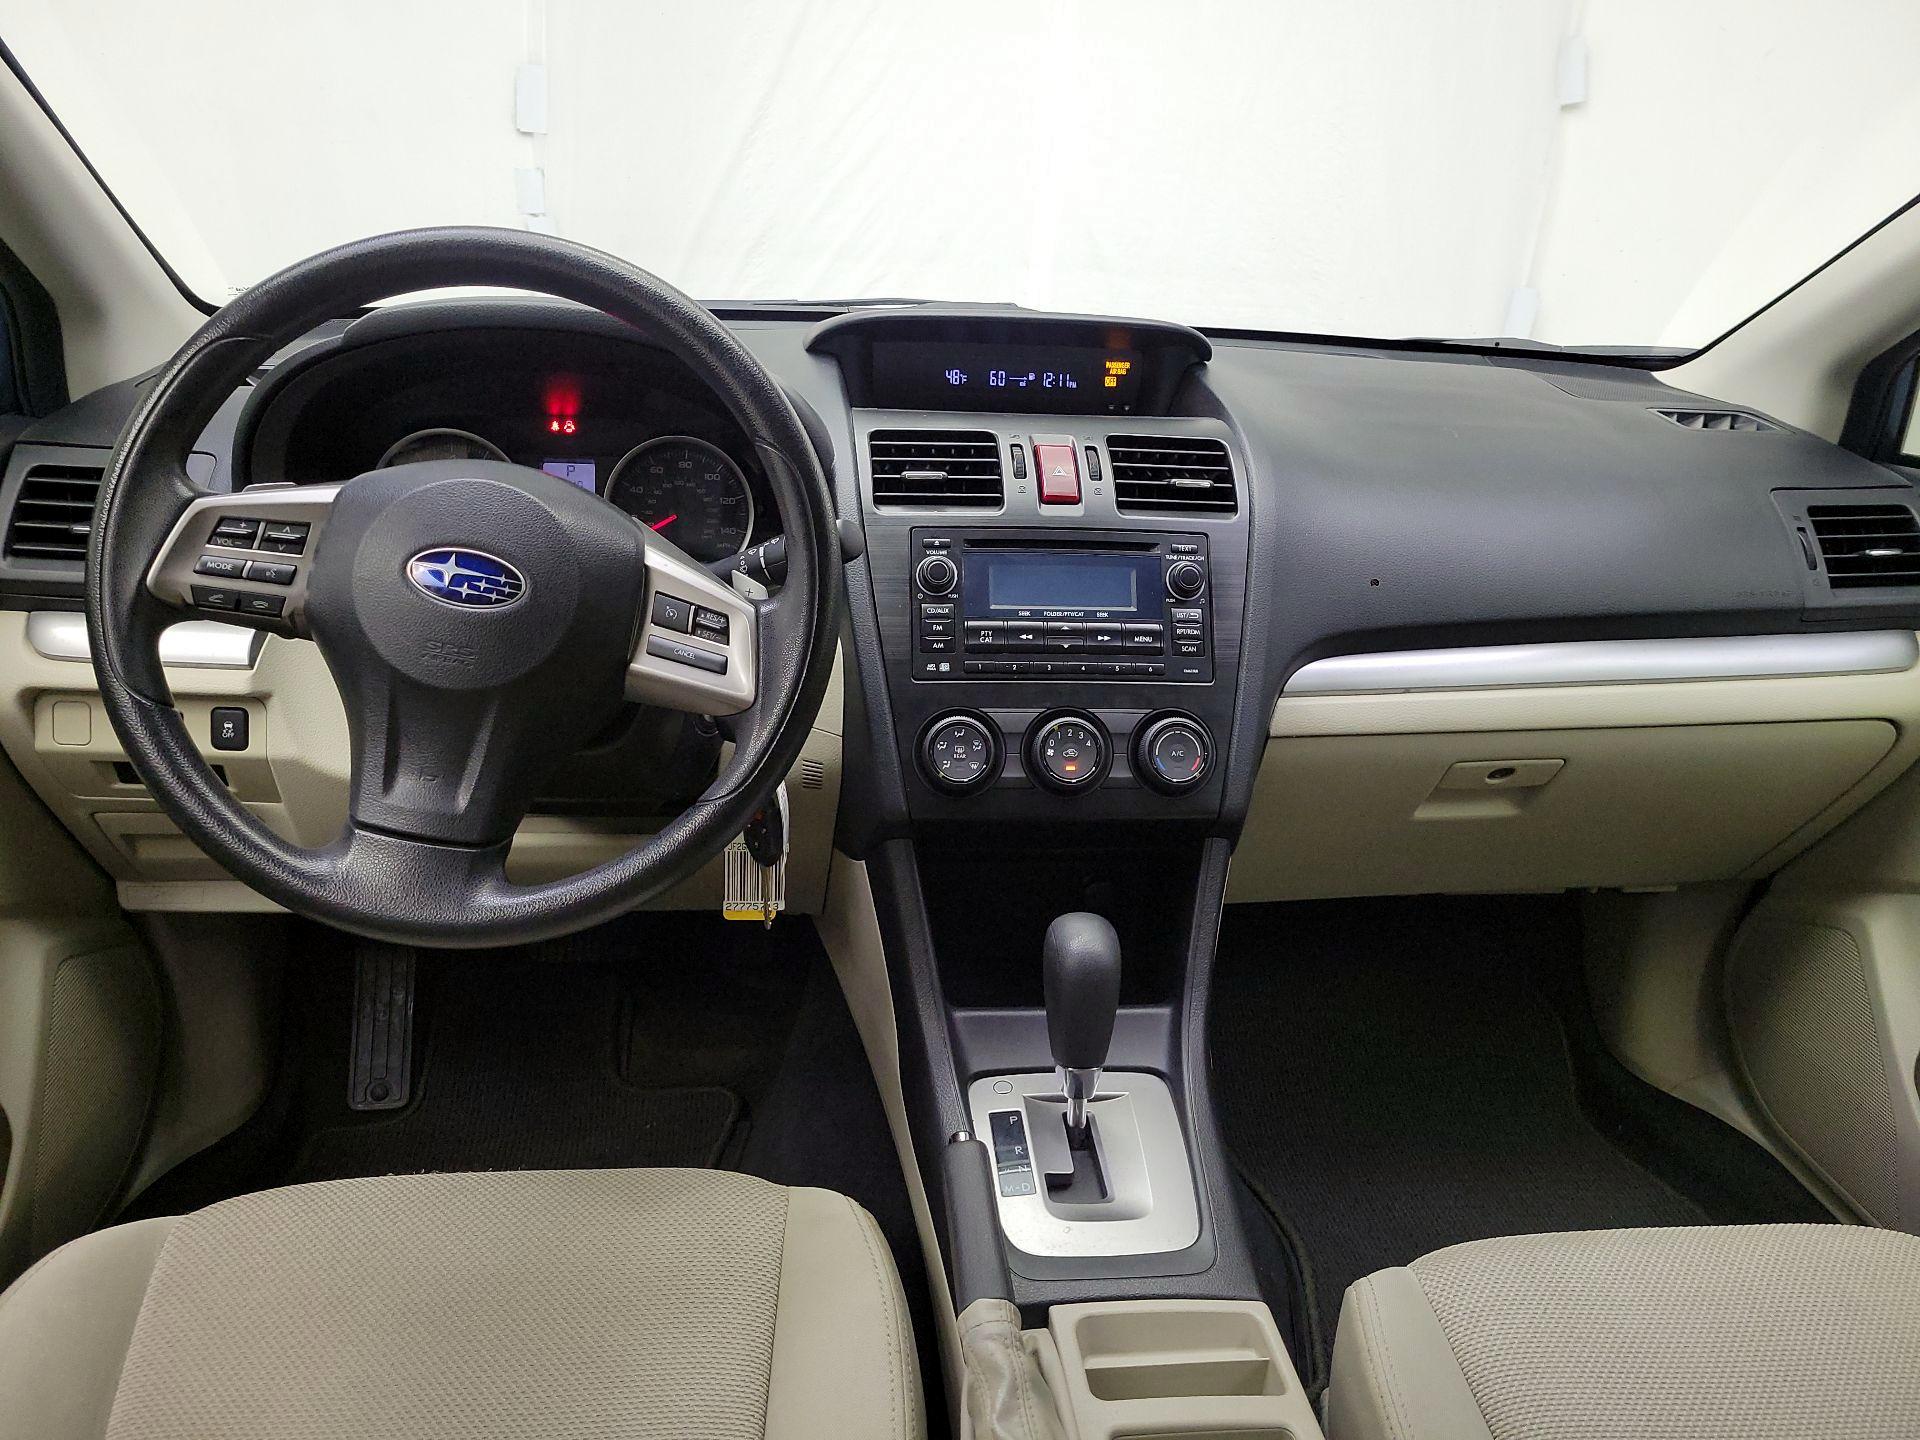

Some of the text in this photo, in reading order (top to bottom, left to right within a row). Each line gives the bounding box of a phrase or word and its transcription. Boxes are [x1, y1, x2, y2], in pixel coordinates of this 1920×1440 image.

[990, 370, 1006, 386] 60
[1105, 376, 1116, 386] OFF
[566, 464, 576, 477] P
[216, 538, 234, 546] VOL
[206, 562, 234, 570] MODE
[674, 648, 696, 660] CANCEL
[1058, 732, 1062, 740] 1
[1068, 729, 1072, 737] 2
[1078, 732, 1084, 740] 3
[1050, 739, 1054, 748] 0
[1086, 740, 1091, 748] 4
[726, 902, 778, 910] 2777573
[1010, 1116, 1018, 1124] P
[1015, 1146, 1024, 1154] R
